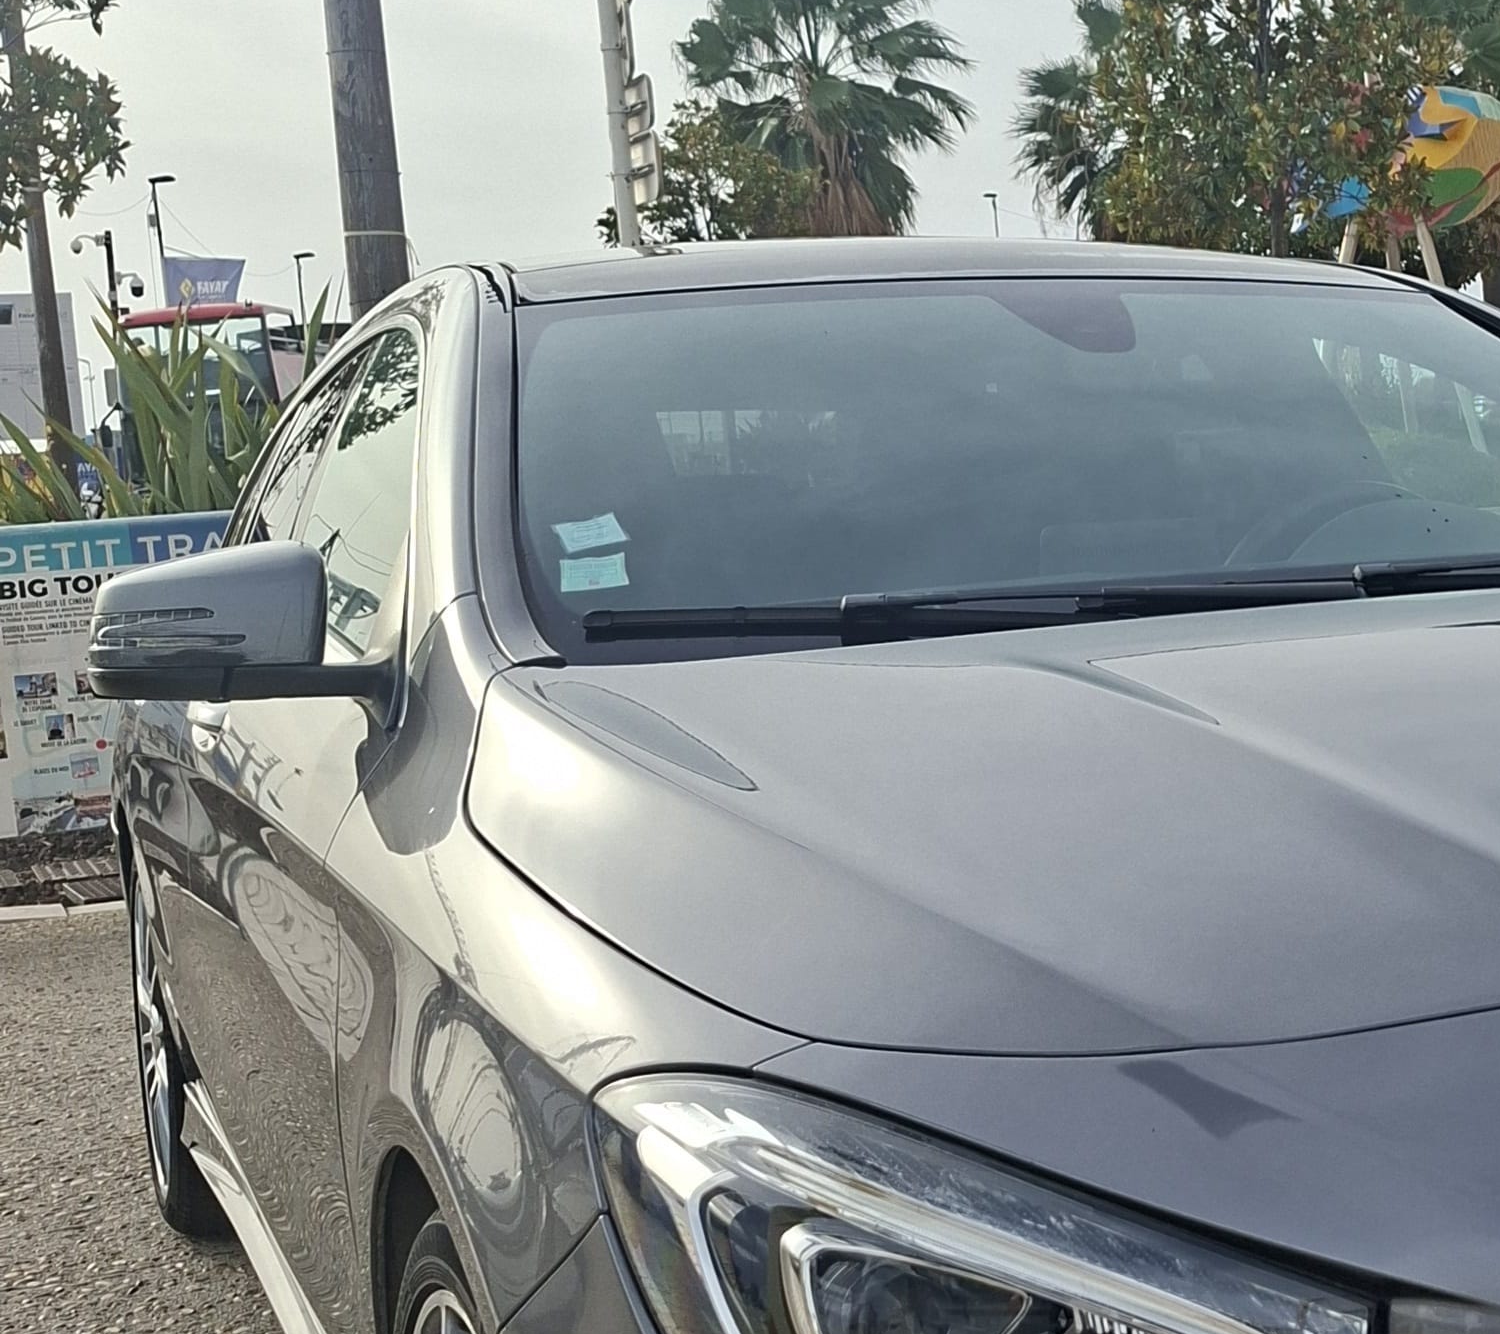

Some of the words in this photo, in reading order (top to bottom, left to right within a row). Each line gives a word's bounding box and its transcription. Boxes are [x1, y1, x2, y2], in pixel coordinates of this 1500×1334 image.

[197, 280, 229, 294] FAYAT
[0, 538, 120, 573] PETIT
[0, 579, 48, 599] BIG
[45, 599, 57, 608] SUR
[60, 598, 66, 607] LE
[69, 596, 93, 605] CINÉMA
